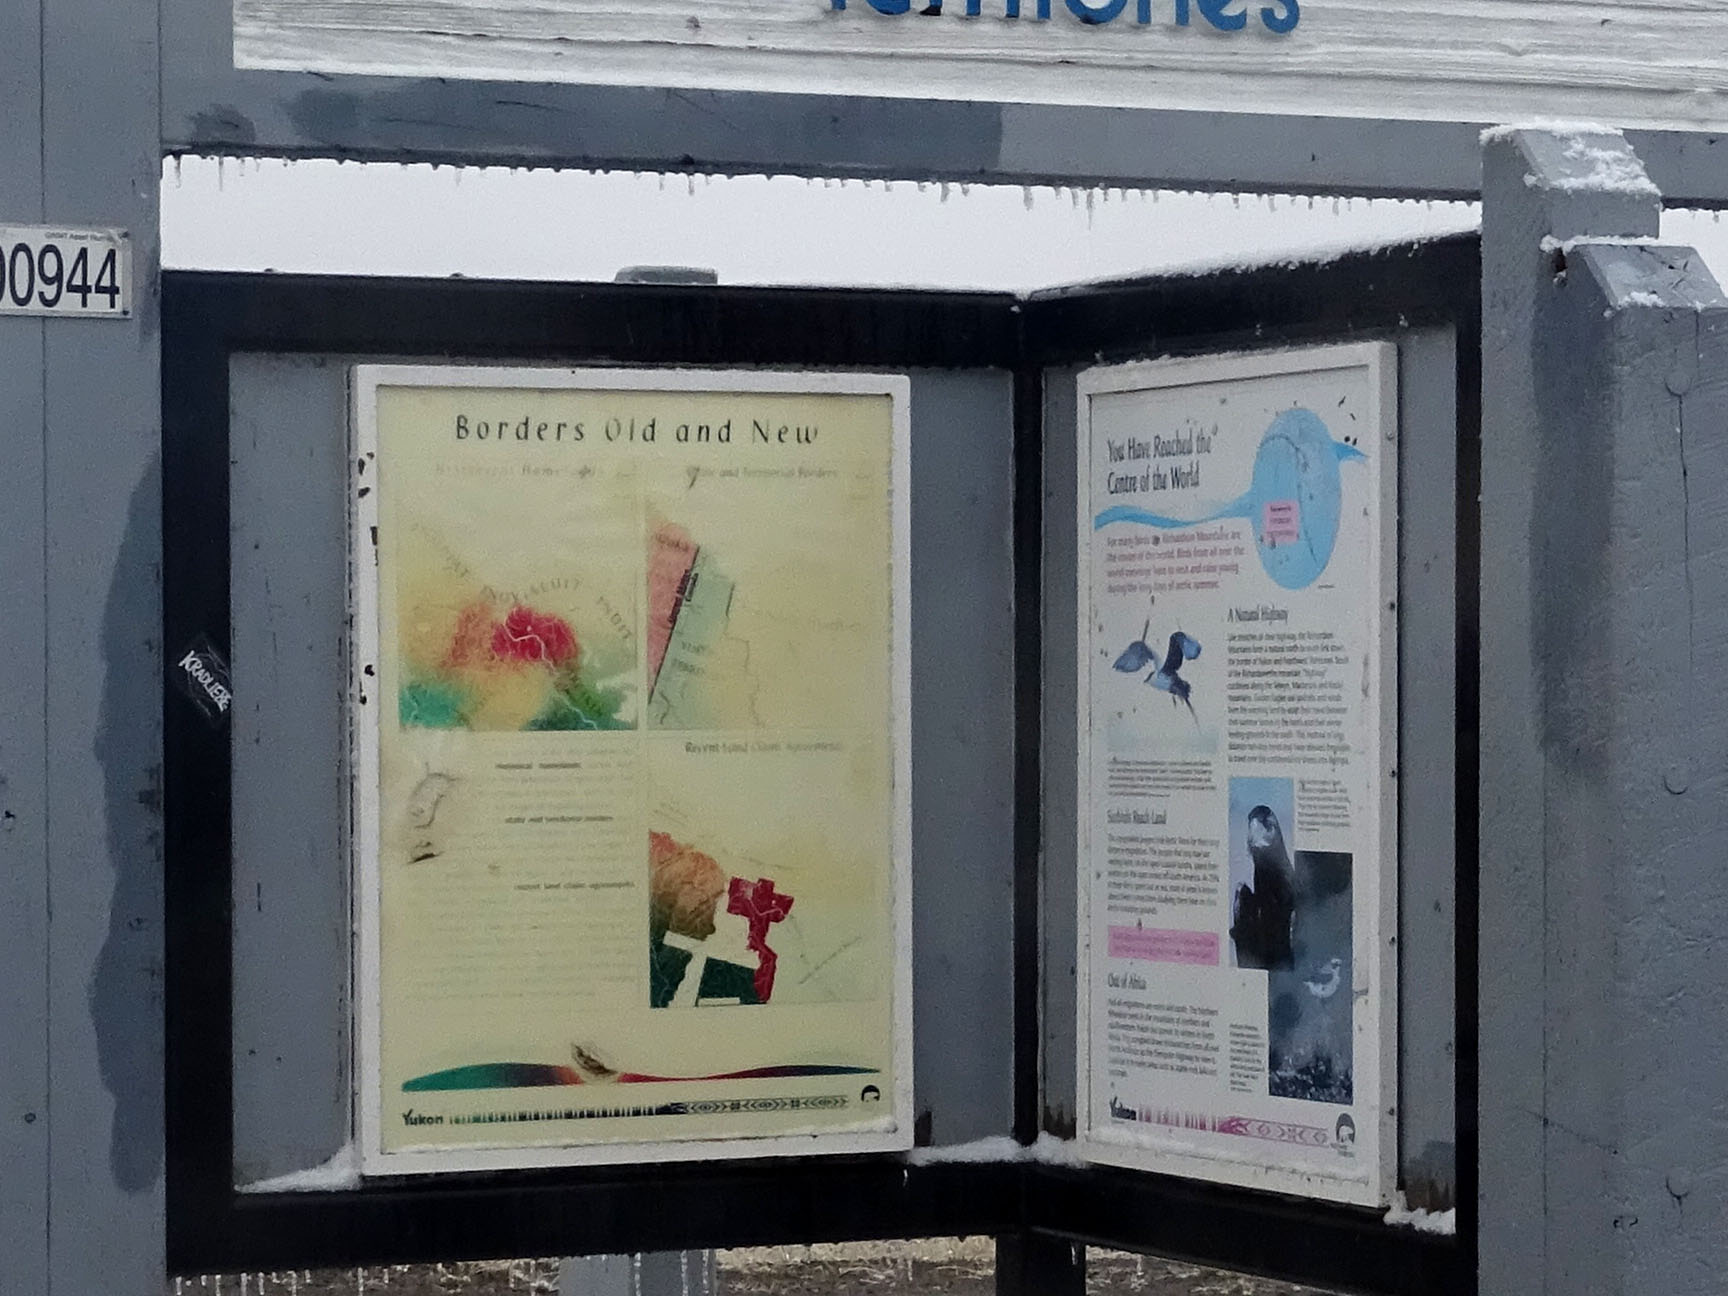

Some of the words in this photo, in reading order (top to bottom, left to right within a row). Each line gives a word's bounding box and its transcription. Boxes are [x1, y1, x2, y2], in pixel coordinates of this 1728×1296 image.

[455, 414, 585, 442] Borders
[604, 416, 657, 443] Old
[675, 418, 732, 444] and
[752, 418, 818, 445] New
[1107, 438, 1125, 463] You
[1128, 435, 1151, 460] Have
[1153, 428, 1193, 458] Reached
[1196, 427, 1212, 454] the
[1107, 471, 1138, 495] Centre
[1140, 464, 1150, 493] of
[1153, 465, 1168, 491] the
[1170, 460, 1200, 490] World
[402, 1108, 443, 1126] Yukon
